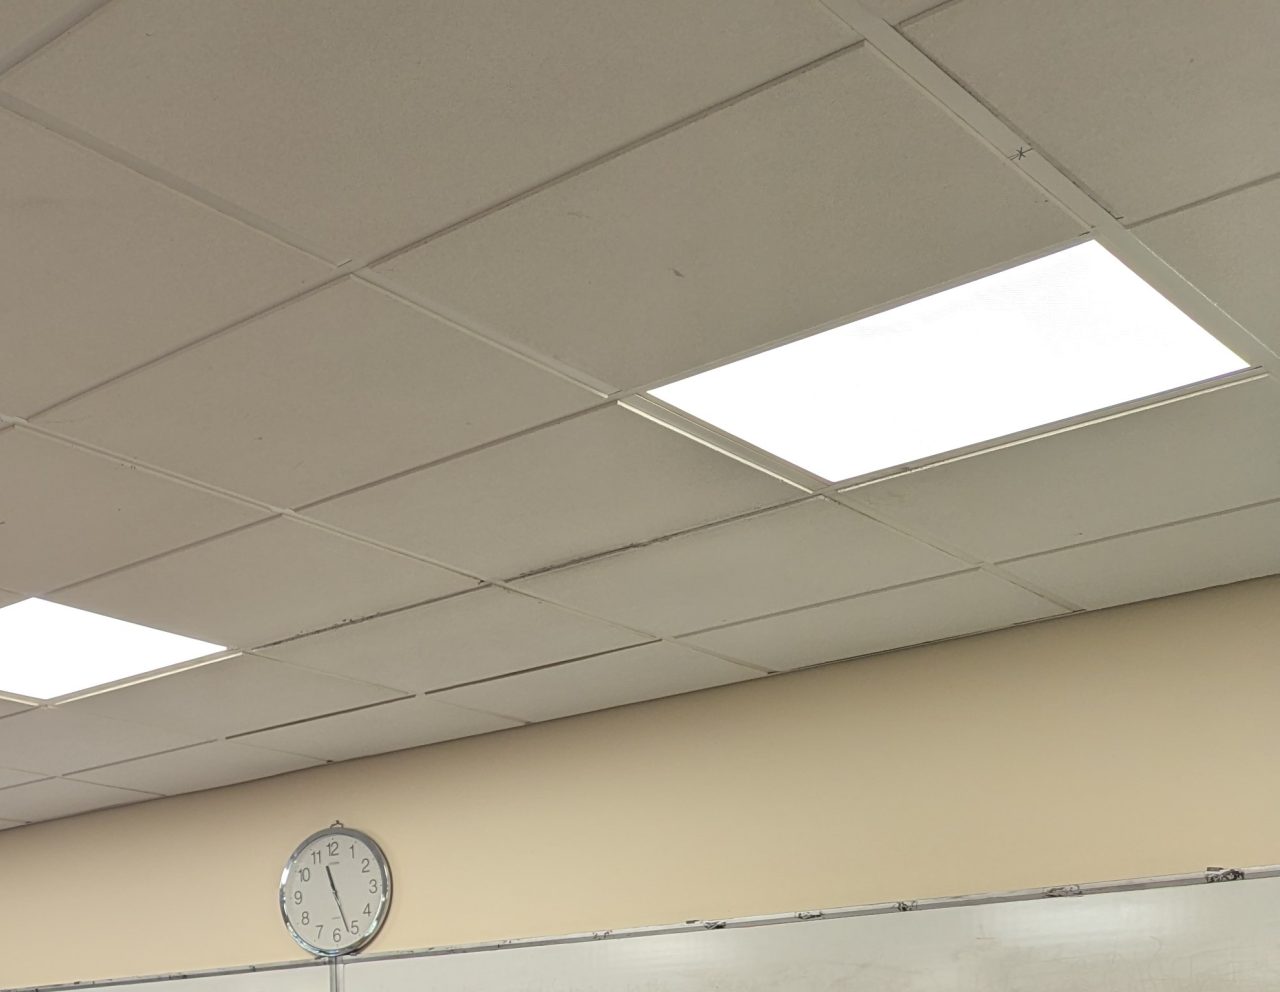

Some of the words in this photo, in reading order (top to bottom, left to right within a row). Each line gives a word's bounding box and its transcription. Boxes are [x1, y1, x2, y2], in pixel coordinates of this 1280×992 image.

[326, 841, 339, 856] 12
[349, 844, 355, 859] 1
[311, 850, 322, 864] 11
[361, 858, 370, 873] 2
[298, 867, 310, 882] 10
[369, 879, 378, 894] 3
[294, 891, 302, 905] 9
[362, 903, 371, 917] 4
[301, 911, 310, 926] 8
[315, 925, 323, 939] 7
[332, 928, 342, 942] 6
[350, 920, 360, 935] 5
